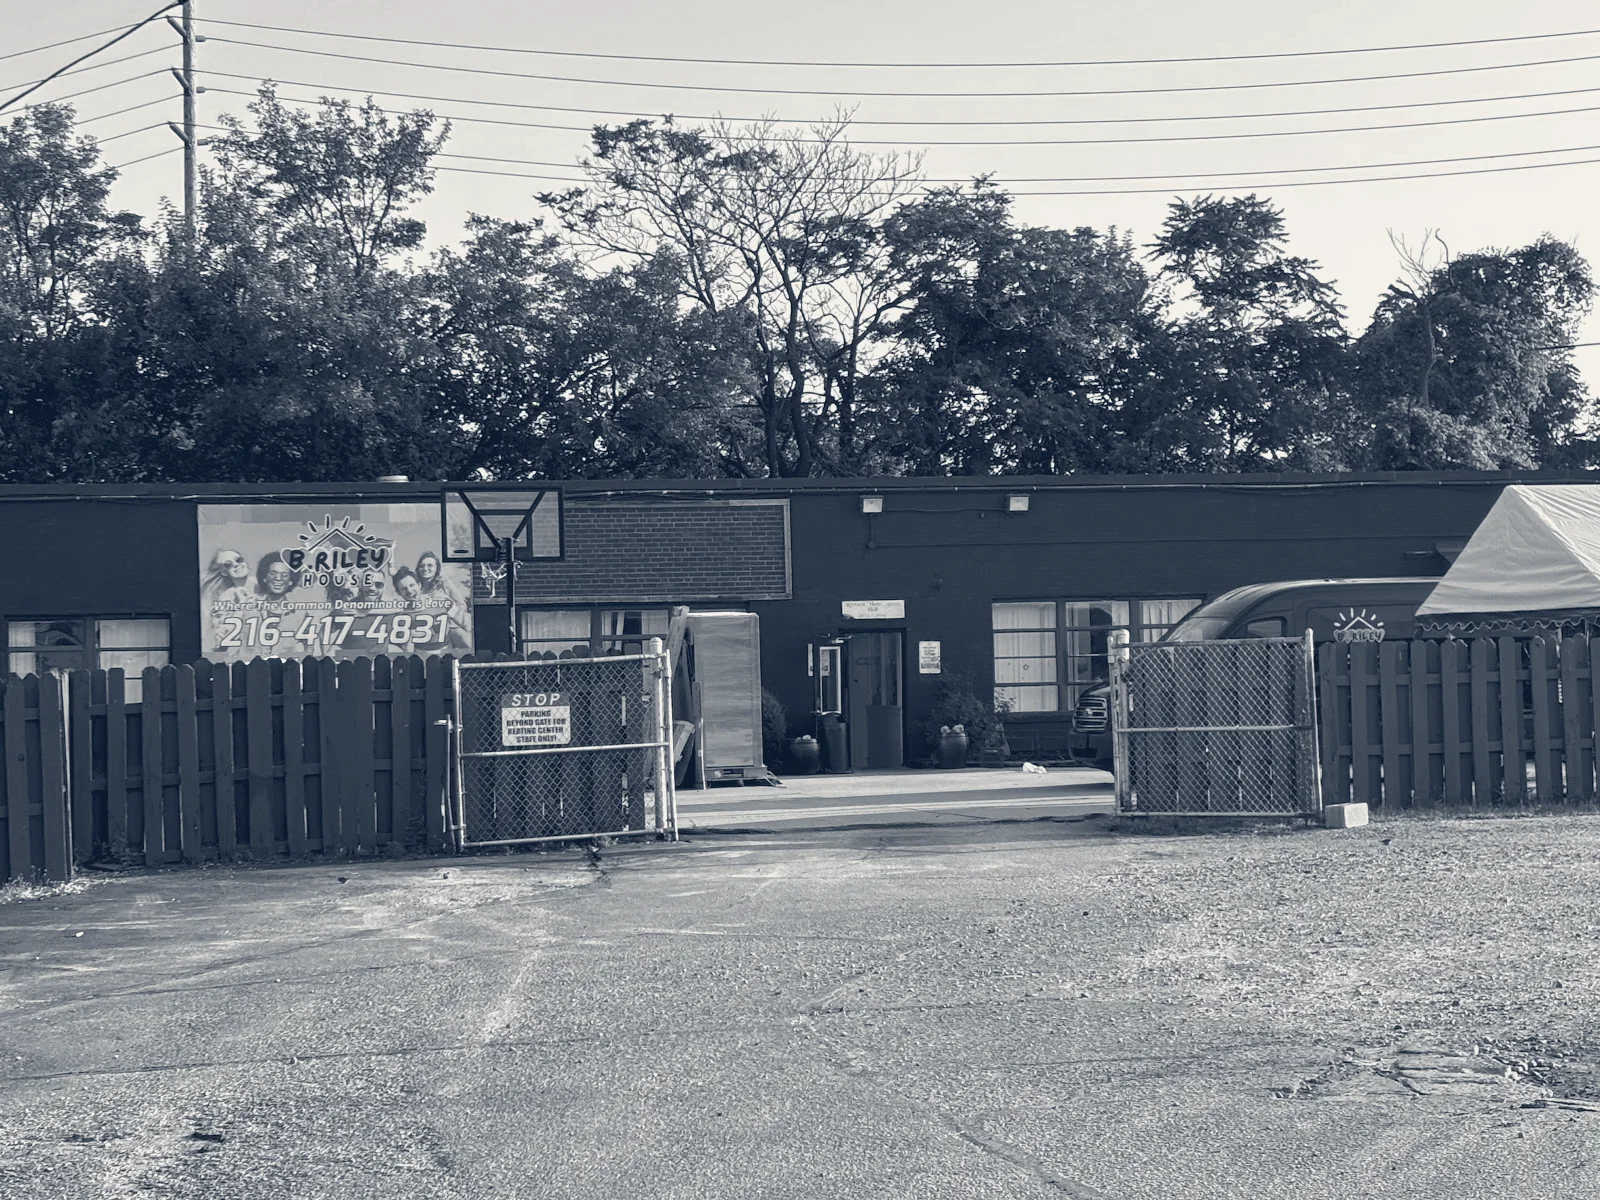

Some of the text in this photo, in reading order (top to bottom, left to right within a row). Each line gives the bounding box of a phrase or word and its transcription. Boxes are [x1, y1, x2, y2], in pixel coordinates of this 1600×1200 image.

[289, 549, 385, 572] B.RILEY
[303, 573, 373, 587] HOUSE
[213, 599, 452, 612] Where The Common Denominator is Love
[220, 614, 450, 647] 216-417-4831
[511, 693, 560, 707] STOP
[521, 710, 551, 718] PARKING
[506, 719, 534, 727] BEYOND
[538, 726, 563, 734] CENTER
[516, 735, 537, 743] STAFF
